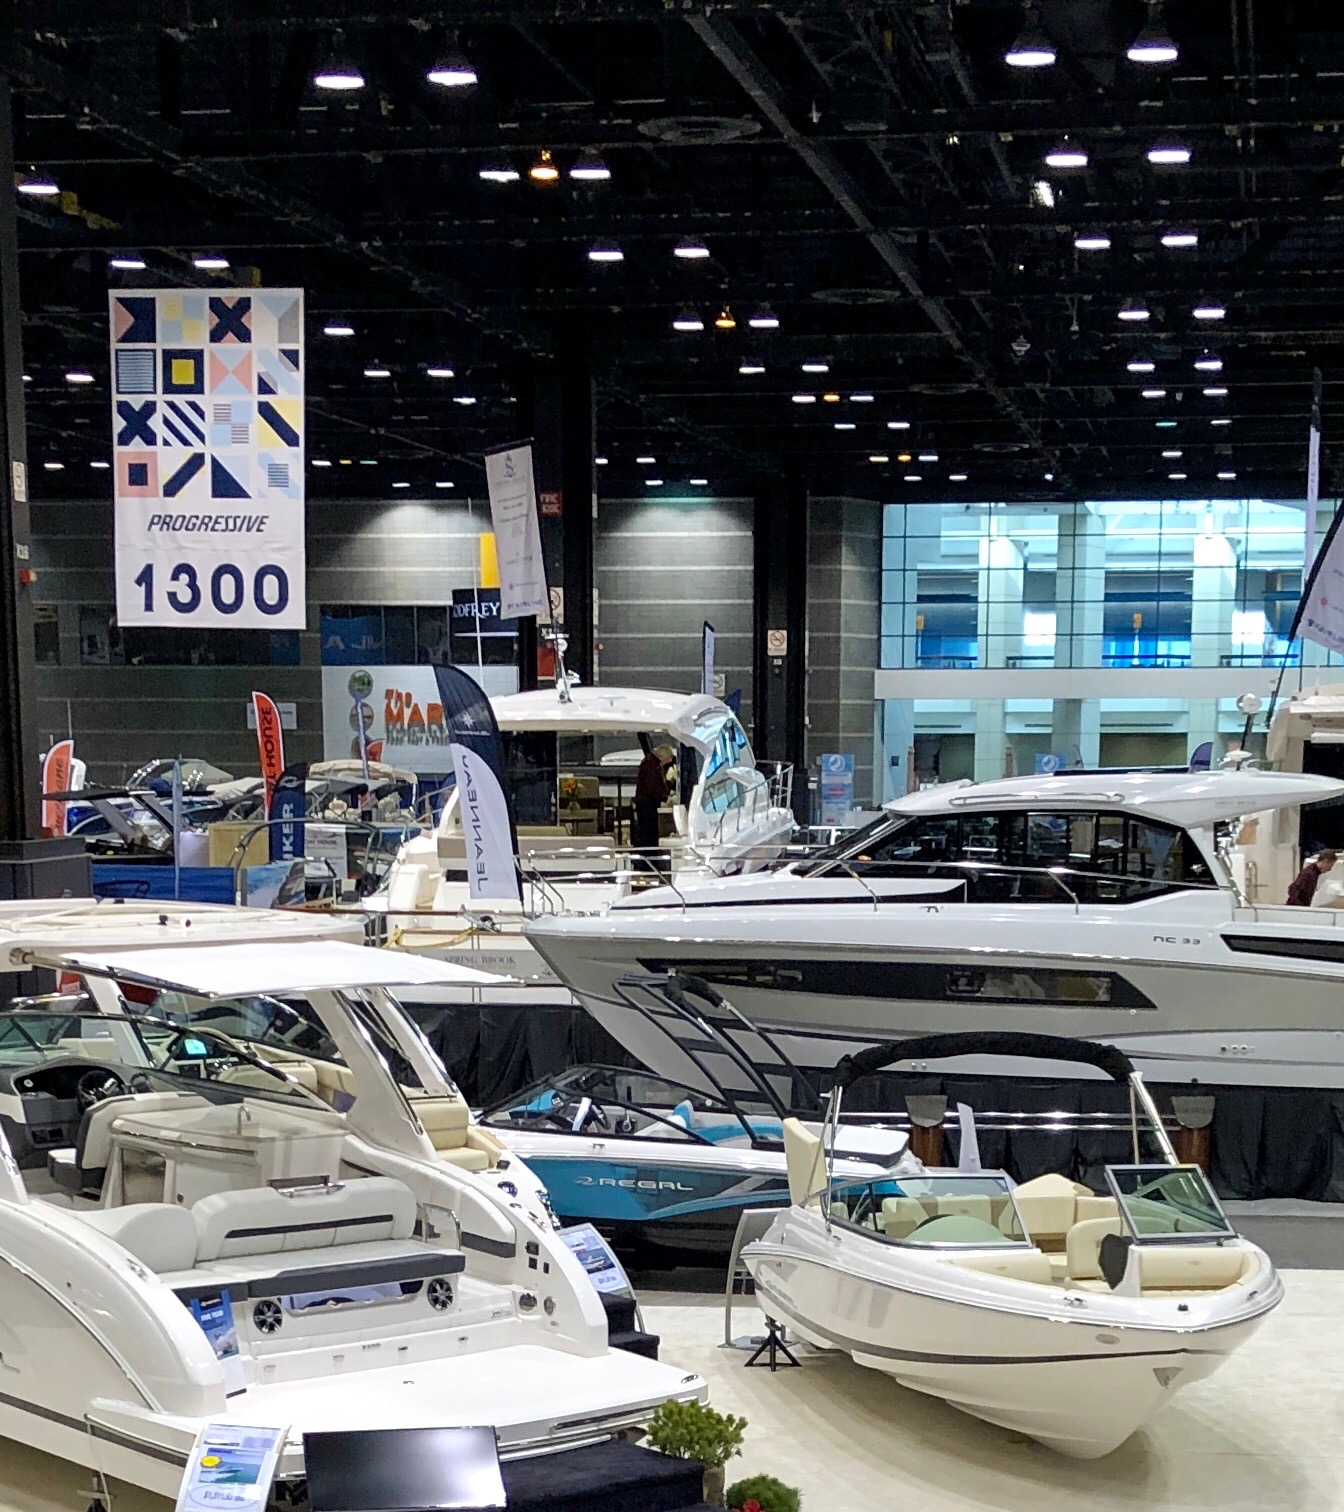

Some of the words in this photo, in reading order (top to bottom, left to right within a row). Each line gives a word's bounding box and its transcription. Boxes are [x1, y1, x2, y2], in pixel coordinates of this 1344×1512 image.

[146, 513, 270, 534] PROGRESSIVE
[133, 562, 290, 614] 1300
[481, 956, 516, 965] BROOK
